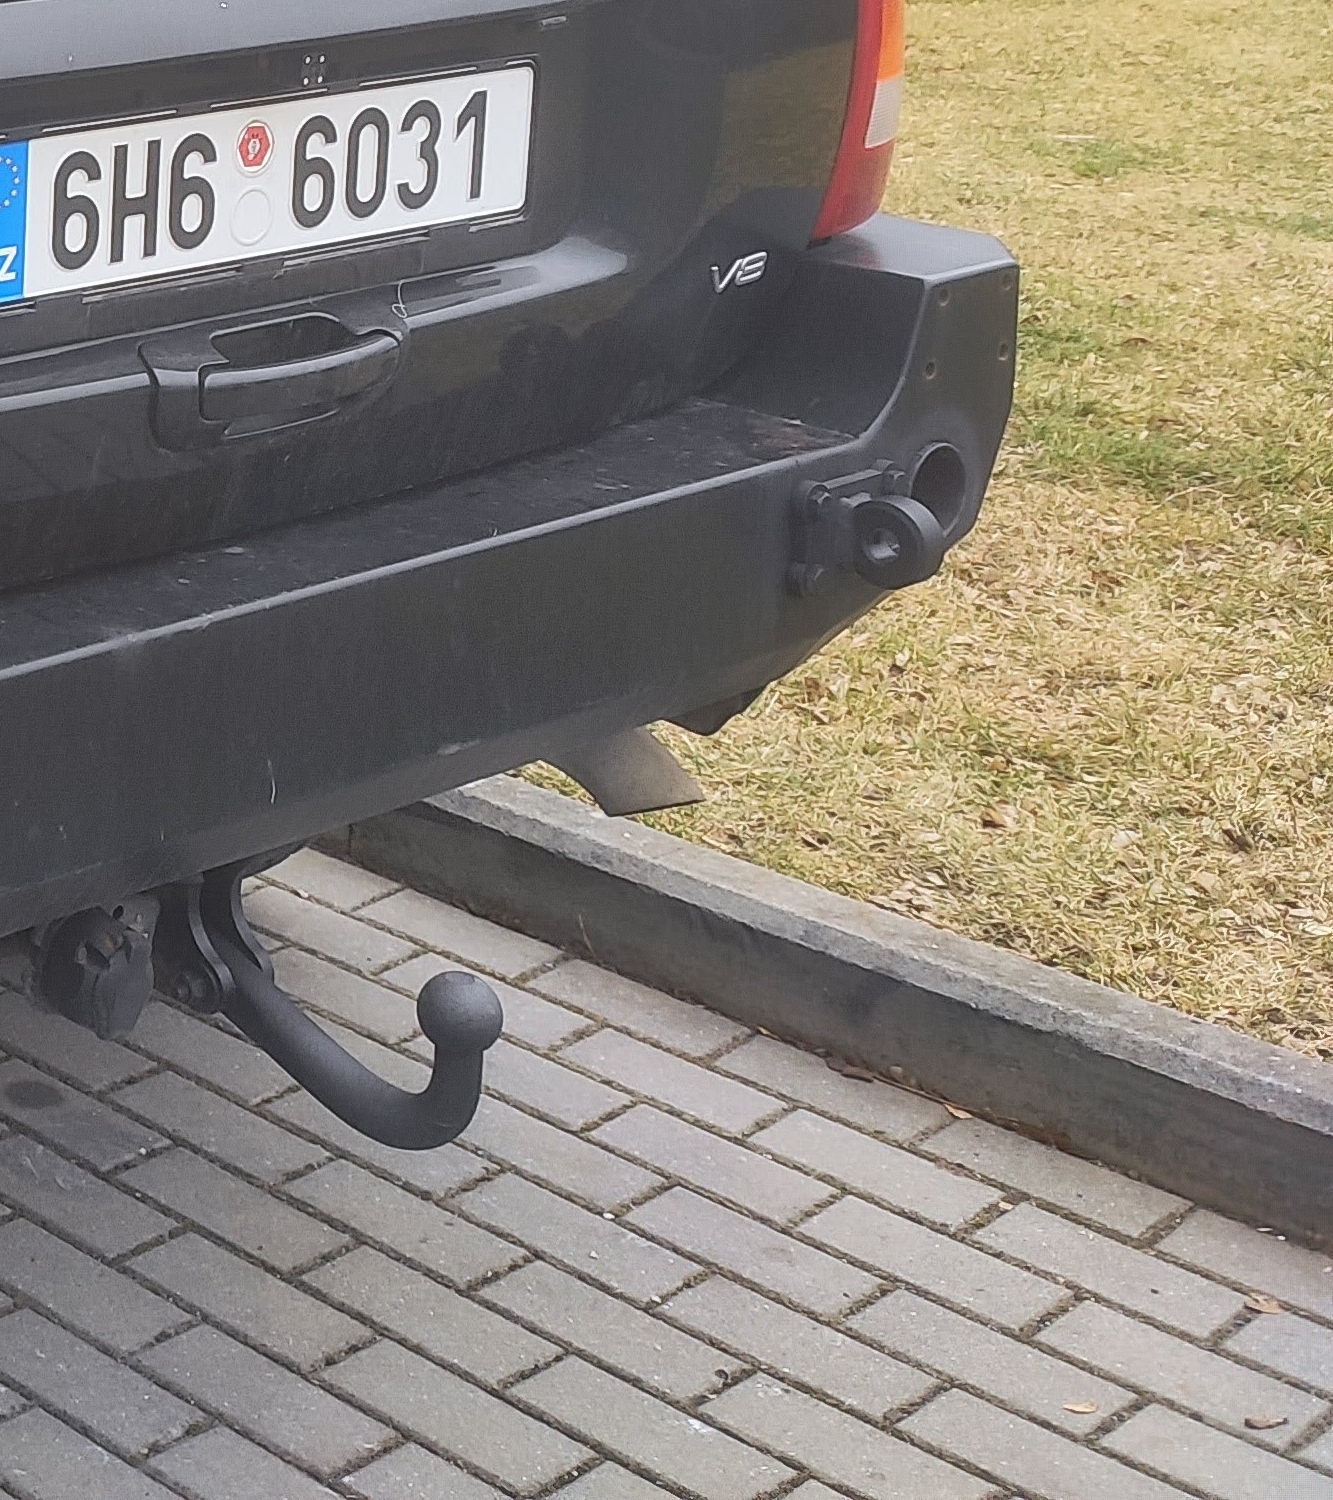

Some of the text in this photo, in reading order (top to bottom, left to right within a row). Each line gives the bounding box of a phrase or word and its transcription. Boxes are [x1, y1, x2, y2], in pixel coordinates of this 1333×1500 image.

[50, 90, 491, 271] 6H6 6031
[710, 251, 767, 294] V8
